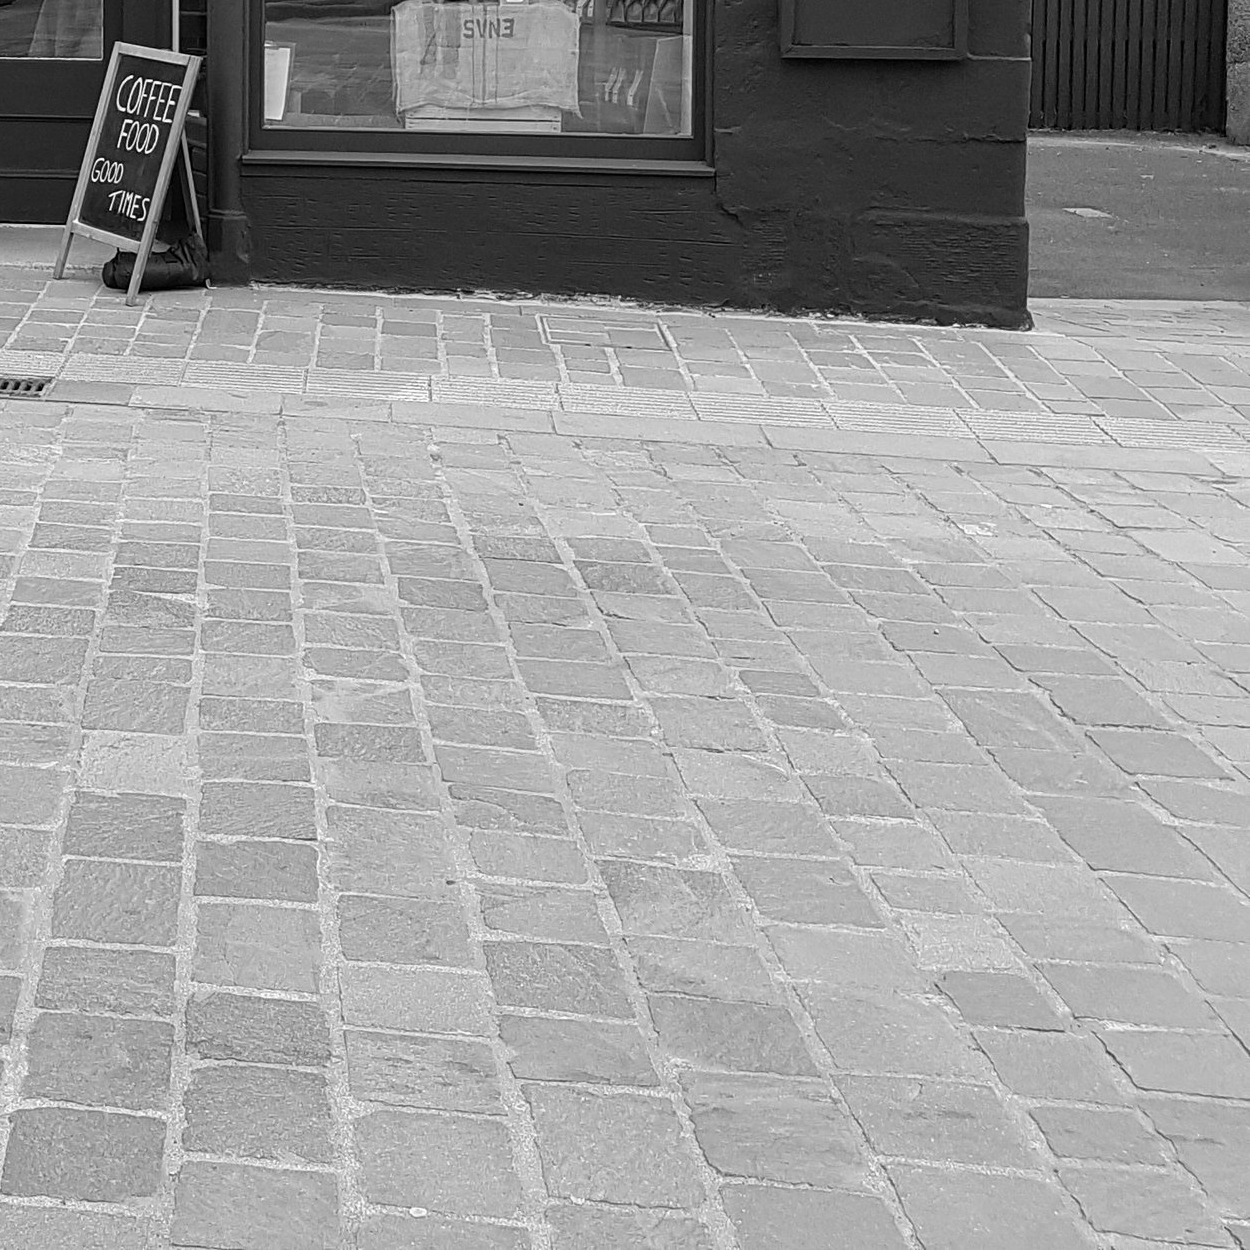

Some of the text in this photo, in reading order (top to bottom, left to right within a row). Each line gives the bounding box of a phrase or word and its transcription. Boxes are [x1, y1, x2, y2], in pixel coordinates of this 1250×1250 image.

[116, 75, 182, 123] COFFEE
[117, 119, 159, 154] FOOD
[91, 157, 124, 184] GOOD
[108, 190, 150, 222] TIMES
